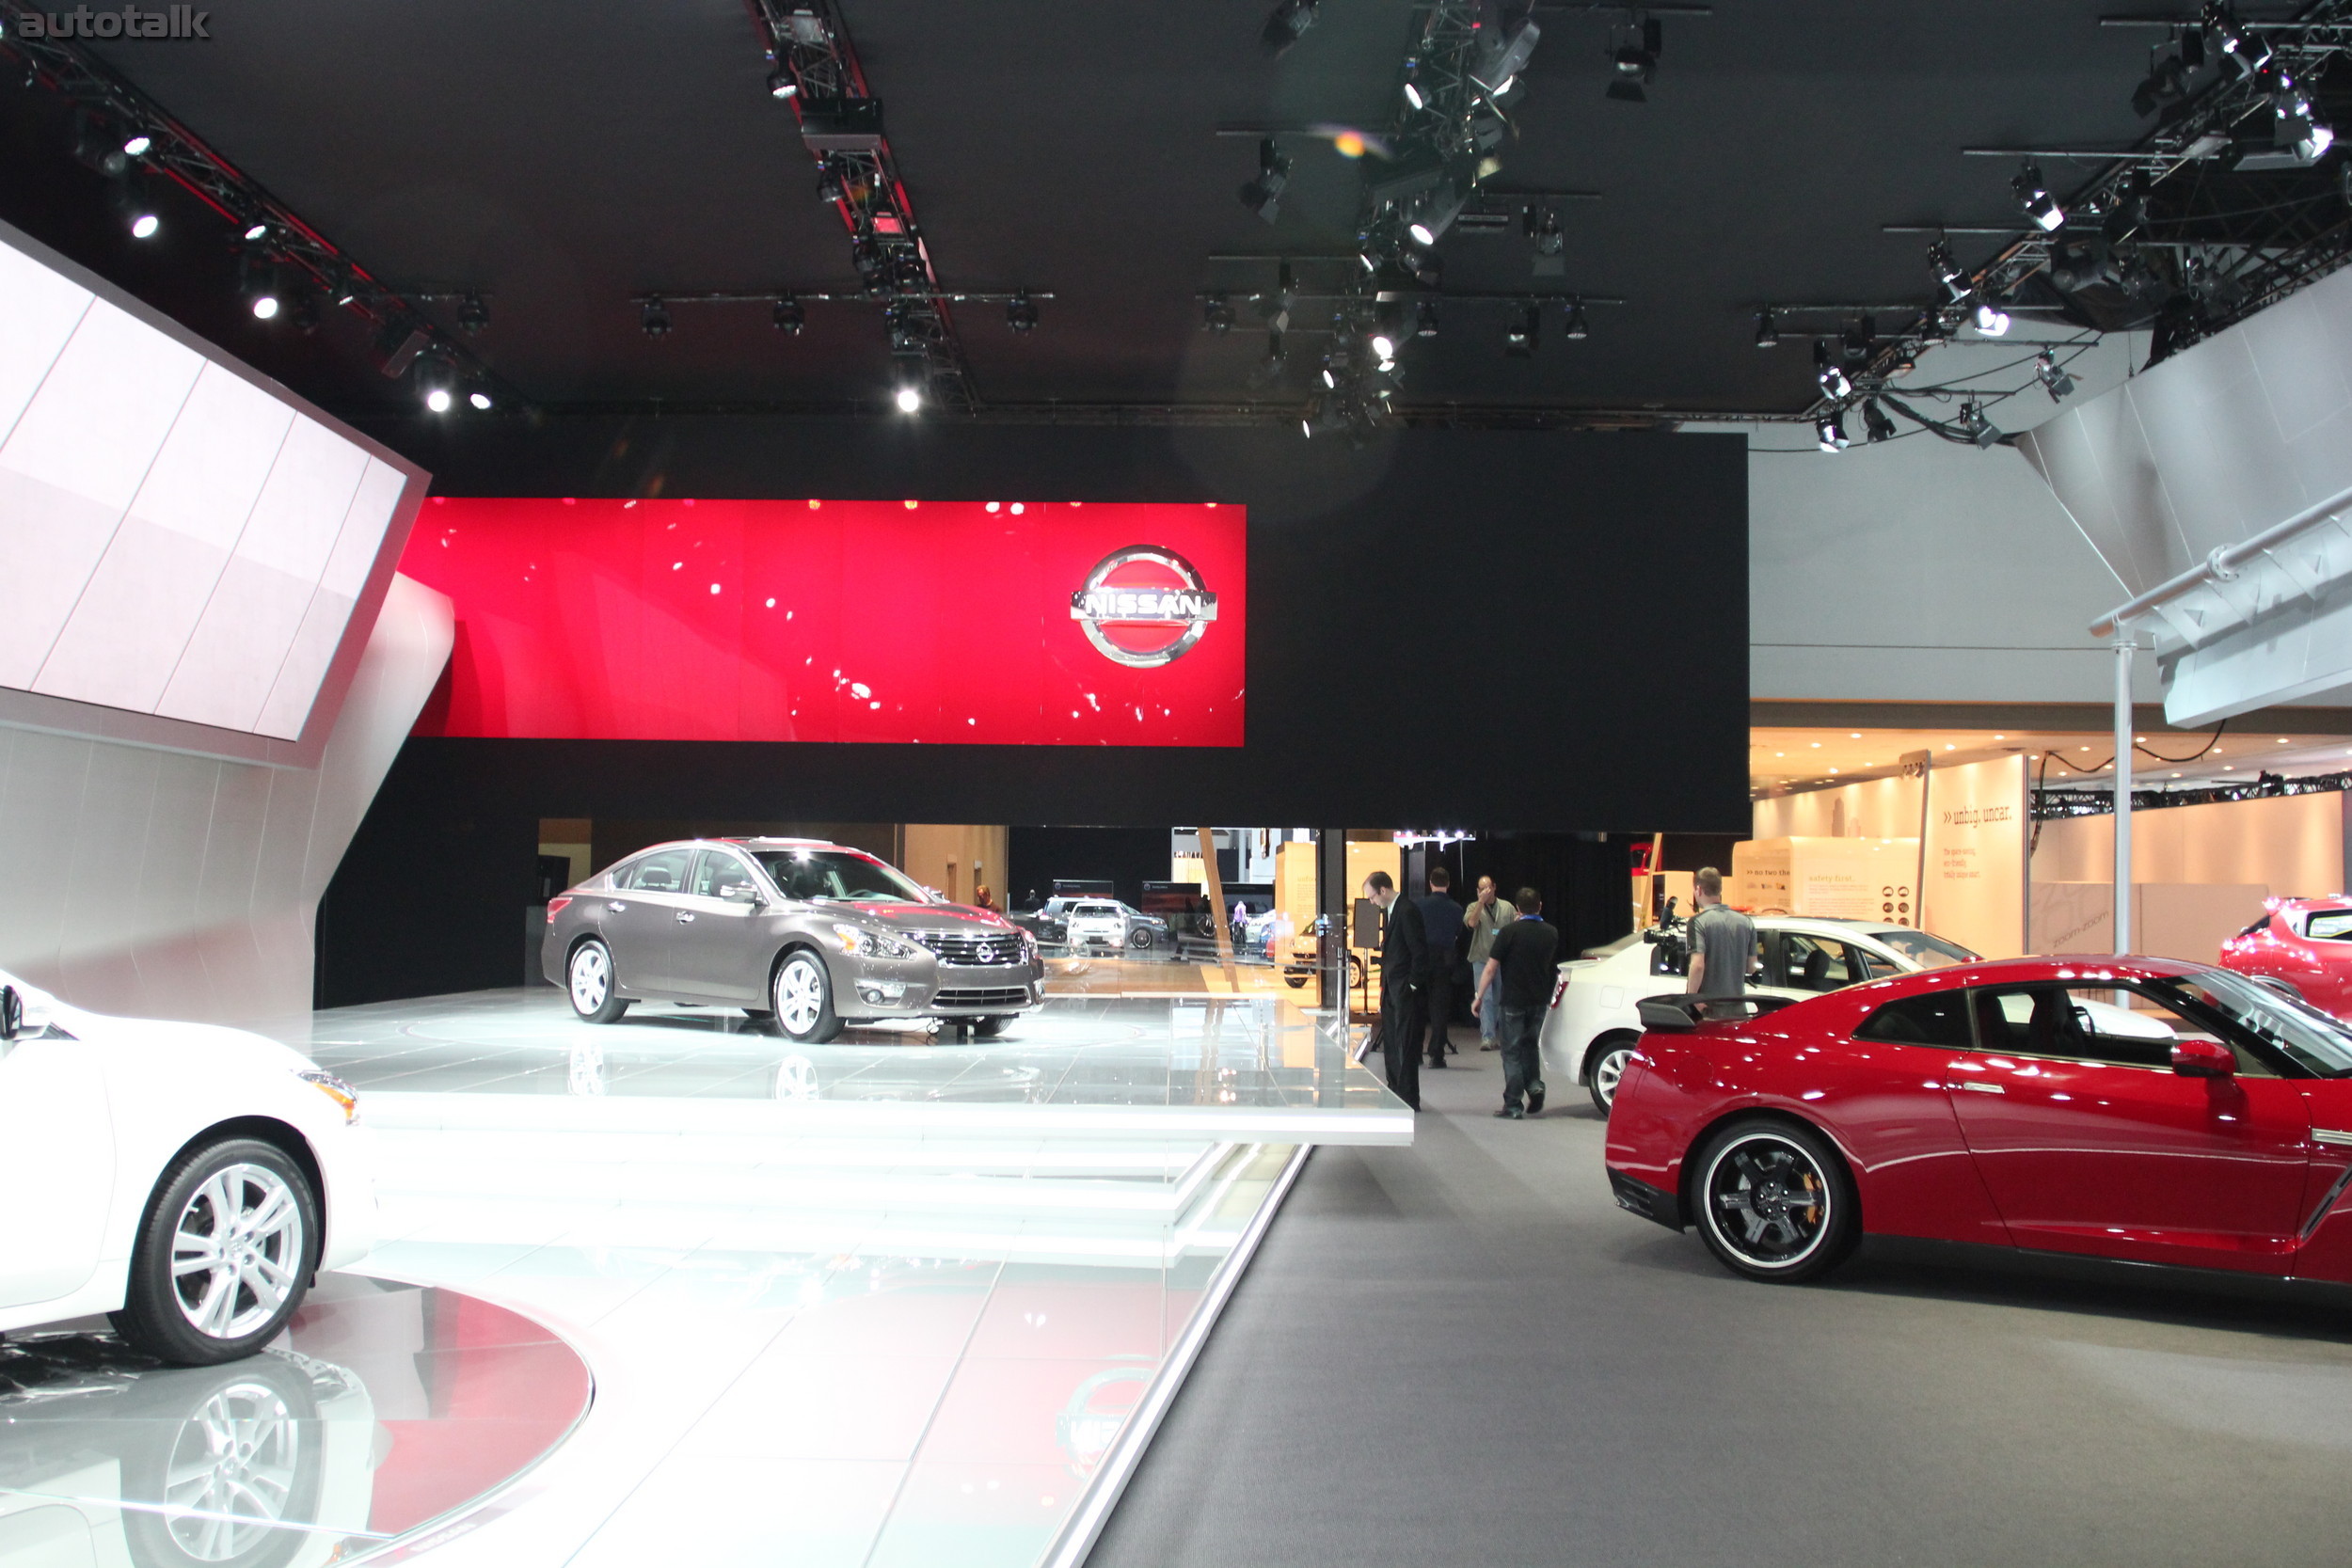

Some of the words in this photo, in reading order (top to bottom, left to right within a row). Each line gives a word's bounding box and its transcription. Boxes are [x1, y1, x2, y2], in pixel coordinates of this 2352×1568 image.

[1085, 594, 1202, 615] NISSAN
[1954, 804, 1980, 829] unbig.
[1983, 806, 2012, 822] uncar.
[1809, 875, 1832, 883] safety
